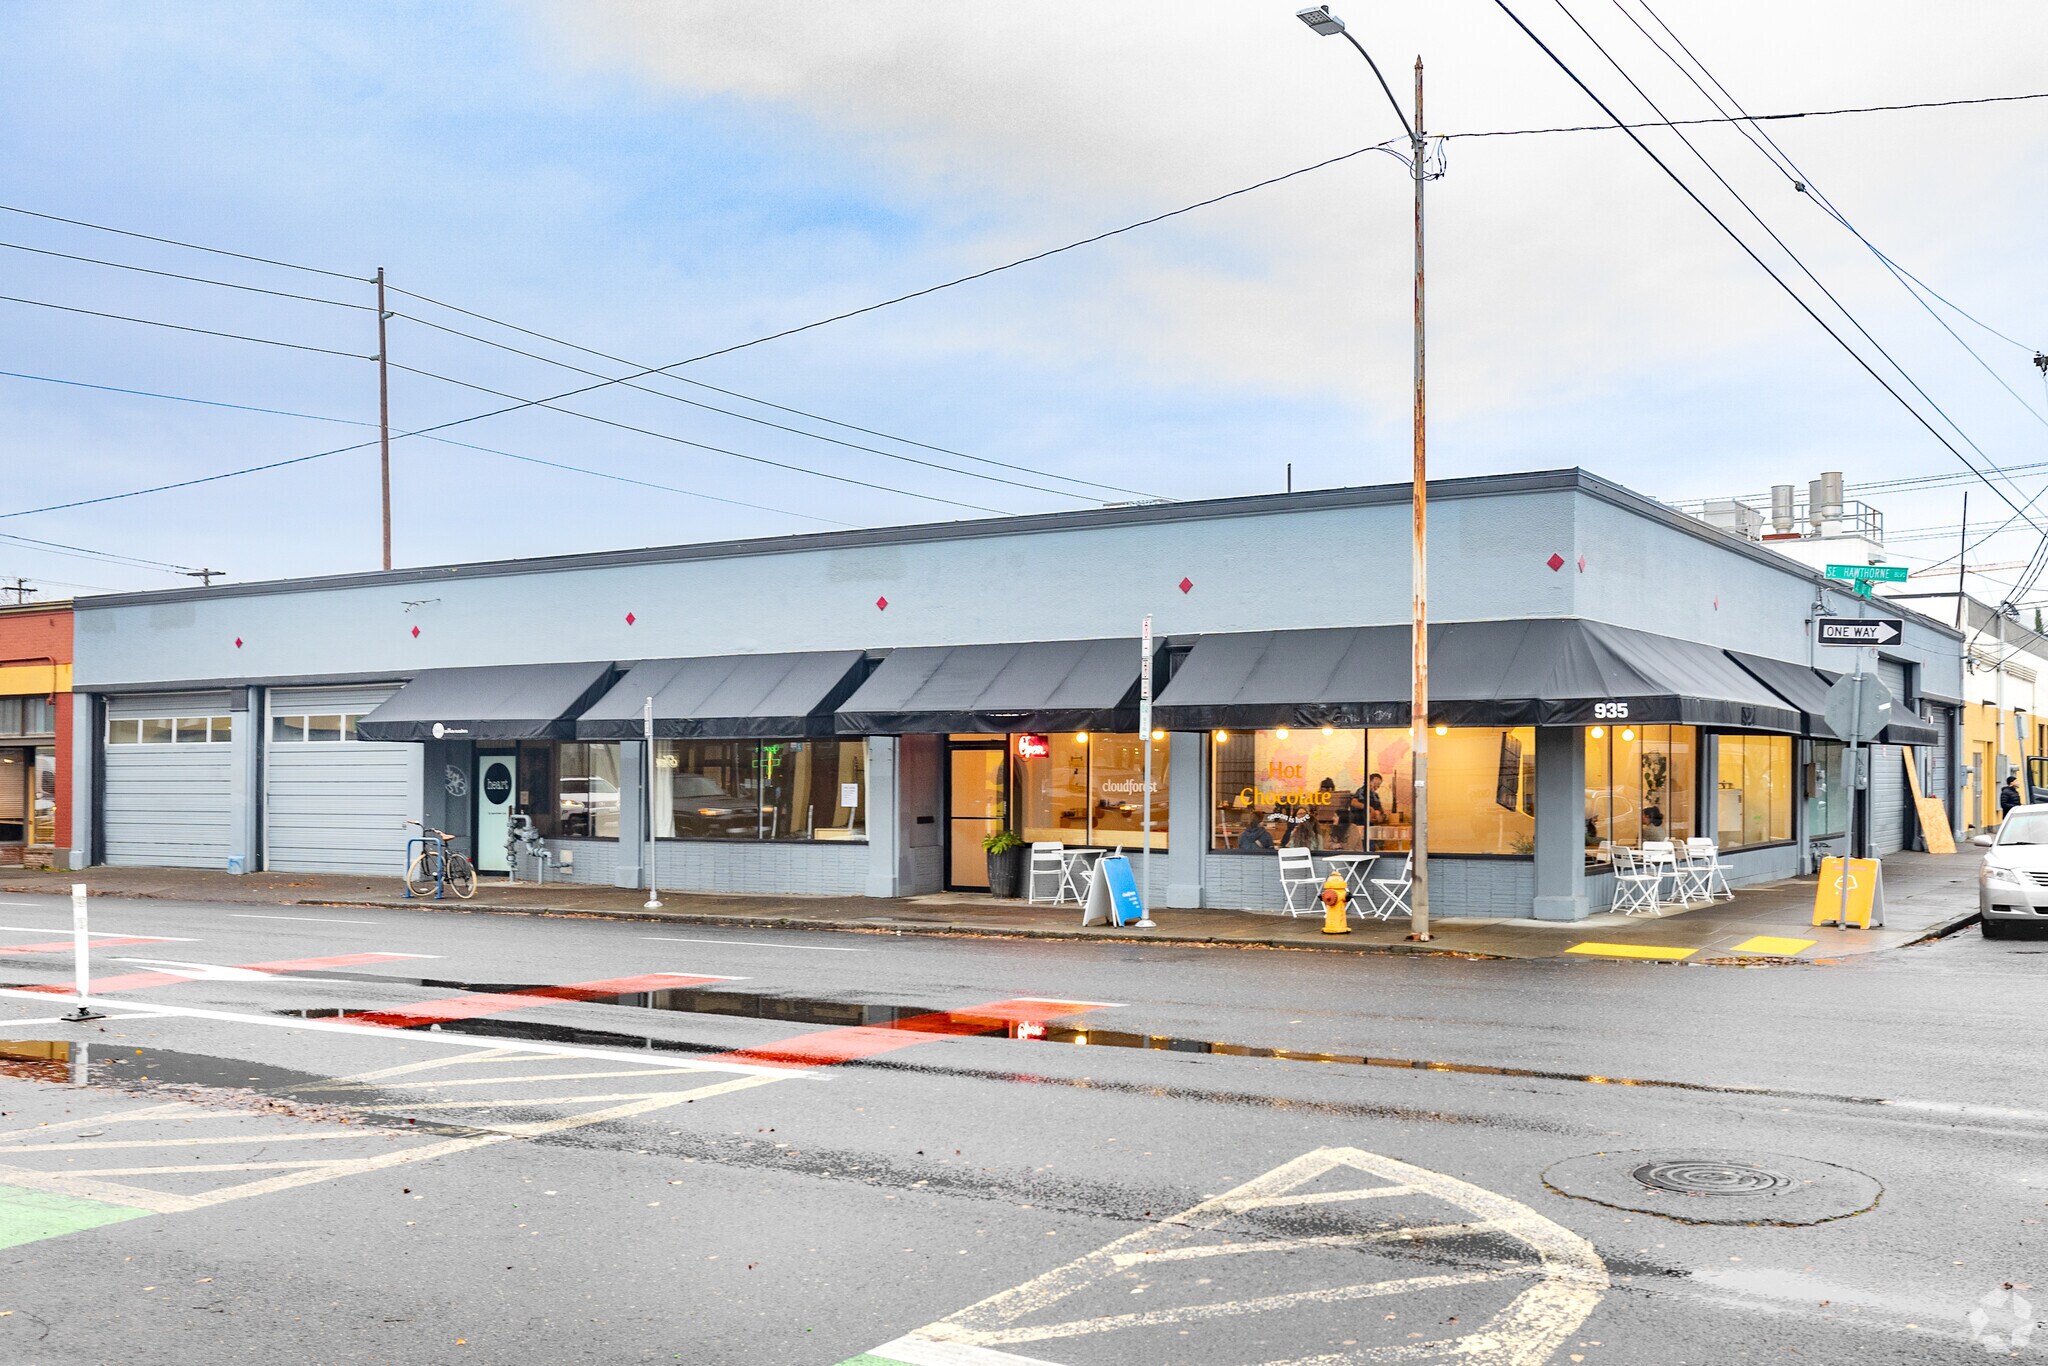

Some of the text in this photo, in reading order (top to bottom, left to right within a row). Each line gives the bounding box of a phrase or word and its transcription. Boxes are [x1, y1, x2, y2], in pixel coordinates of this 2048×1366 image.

[1827, 566, 1837, 577] SE
[1843, 567, 1890, 579] HAWTHORNE
[1826, 626, 1877, 638] ONE WAY
[1593, 702, 1629, 719] 935
[1018, 735, 1046, 758] Open
[1268, 761, 1303, 780] Hot
[486, 778, 509, 790] heart
[1240, 786, 1333, 806] Chocolate
[1289, 815, 1296, 824] is
[1295, 813, 1311, 825] here
